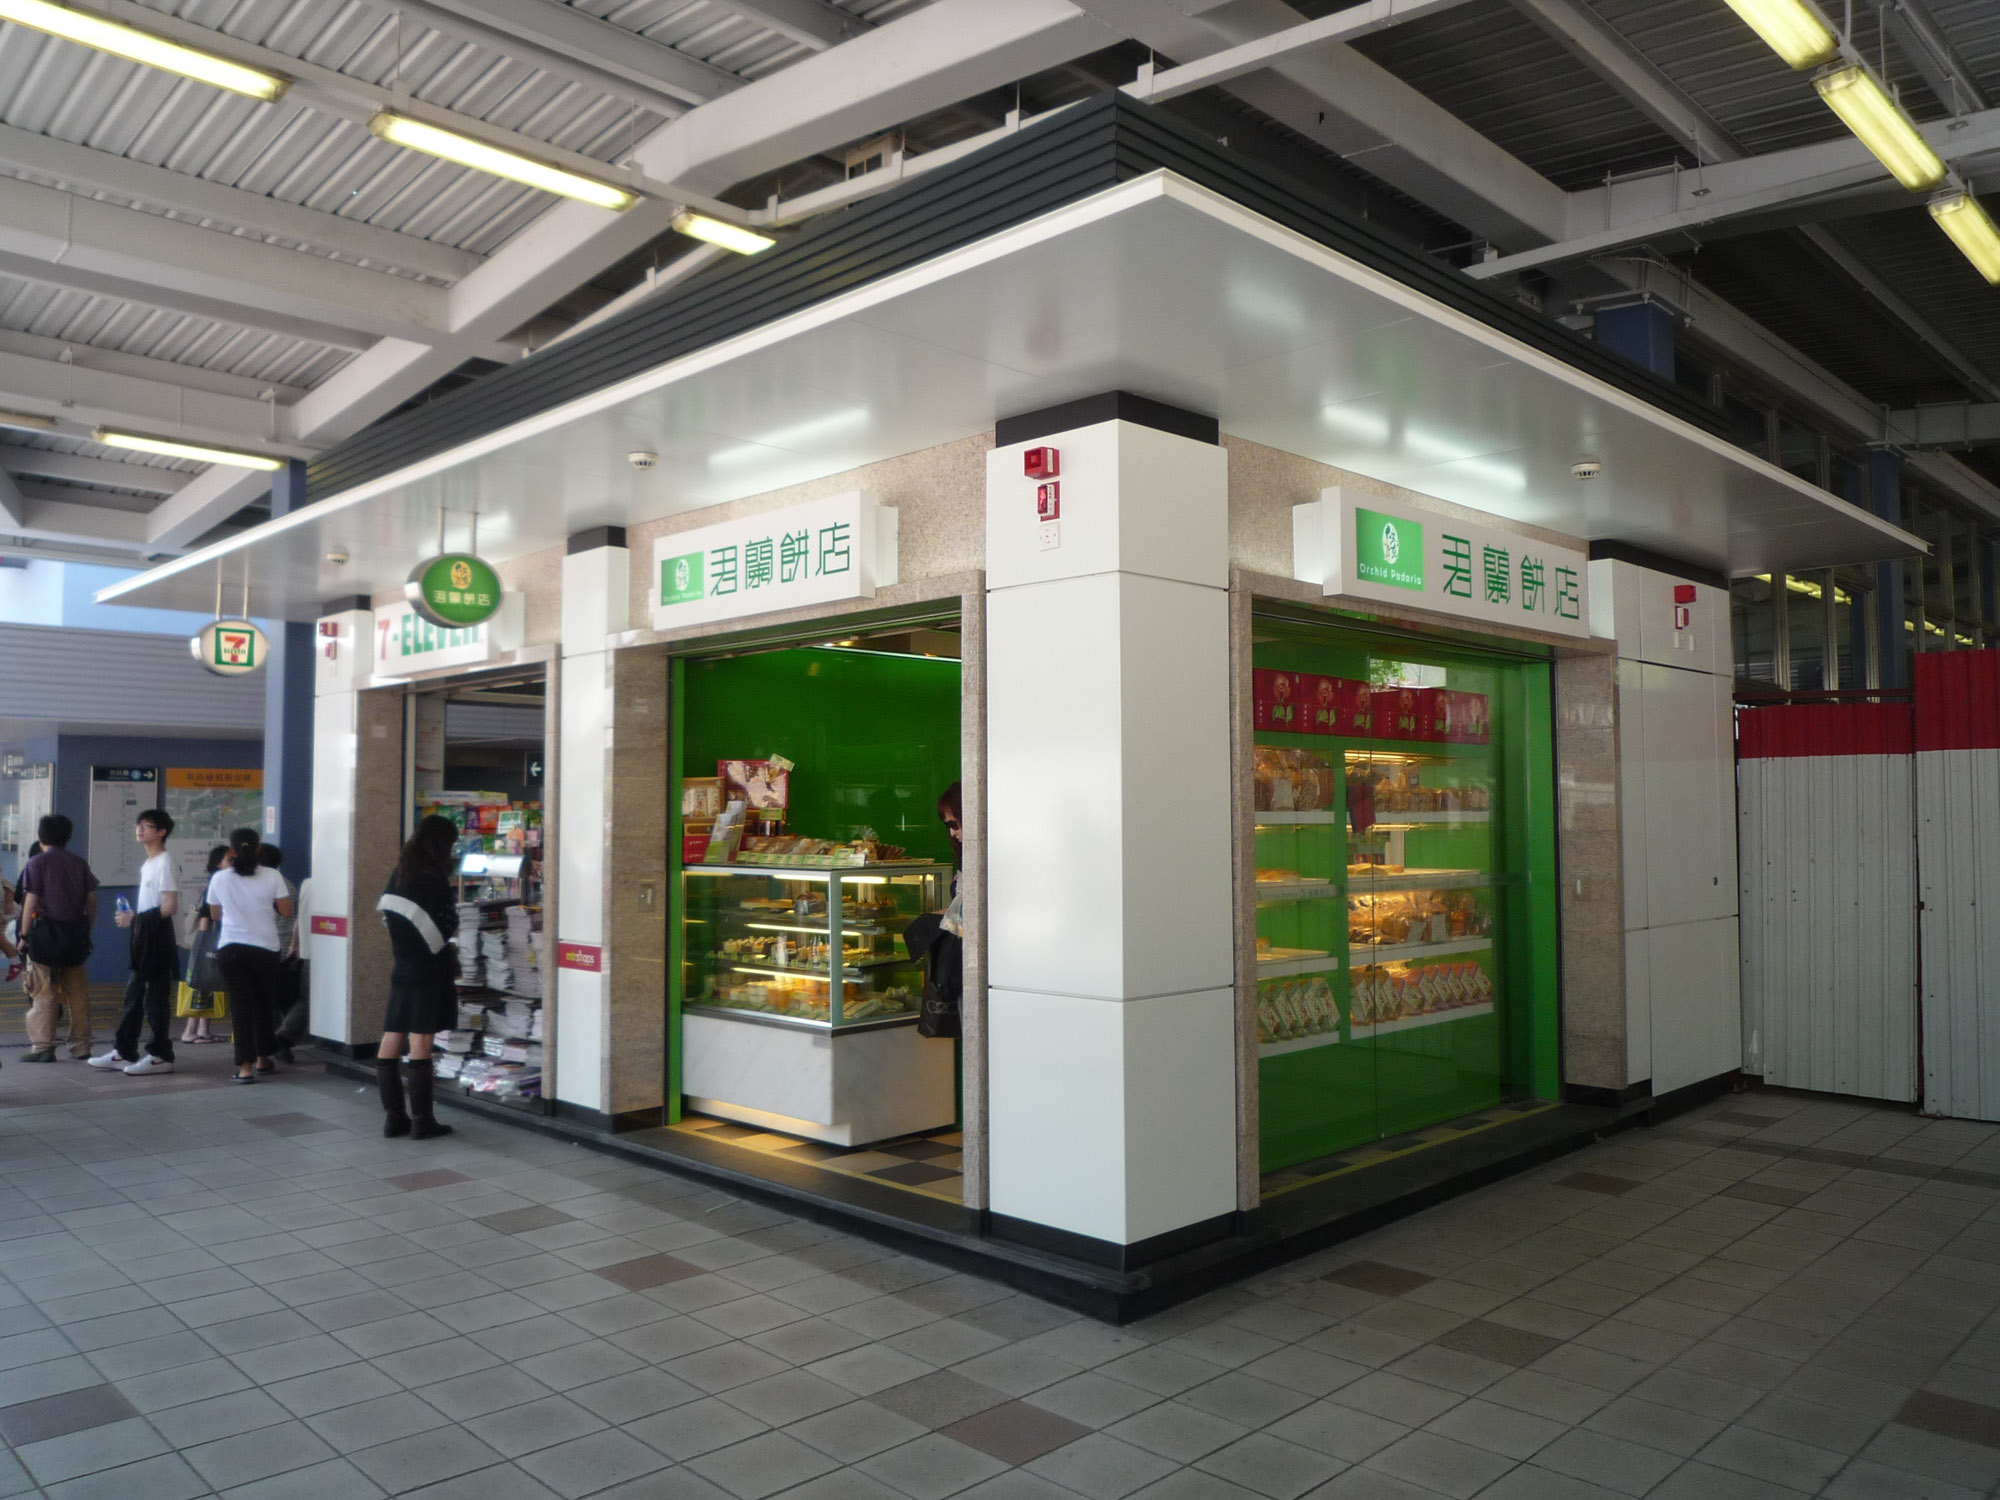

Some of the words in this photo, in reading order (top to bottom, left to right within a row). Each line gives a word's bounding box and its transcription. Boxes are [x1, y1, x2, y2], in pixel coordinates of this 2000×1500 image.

[710, 522, 850, 597] 君蘭餅店
[1360, 562, 1388, 578] Orchid
[1391, 569, 1422, 585] Padaria
[1442, 534, 1580, 620] 君蘭餅店
